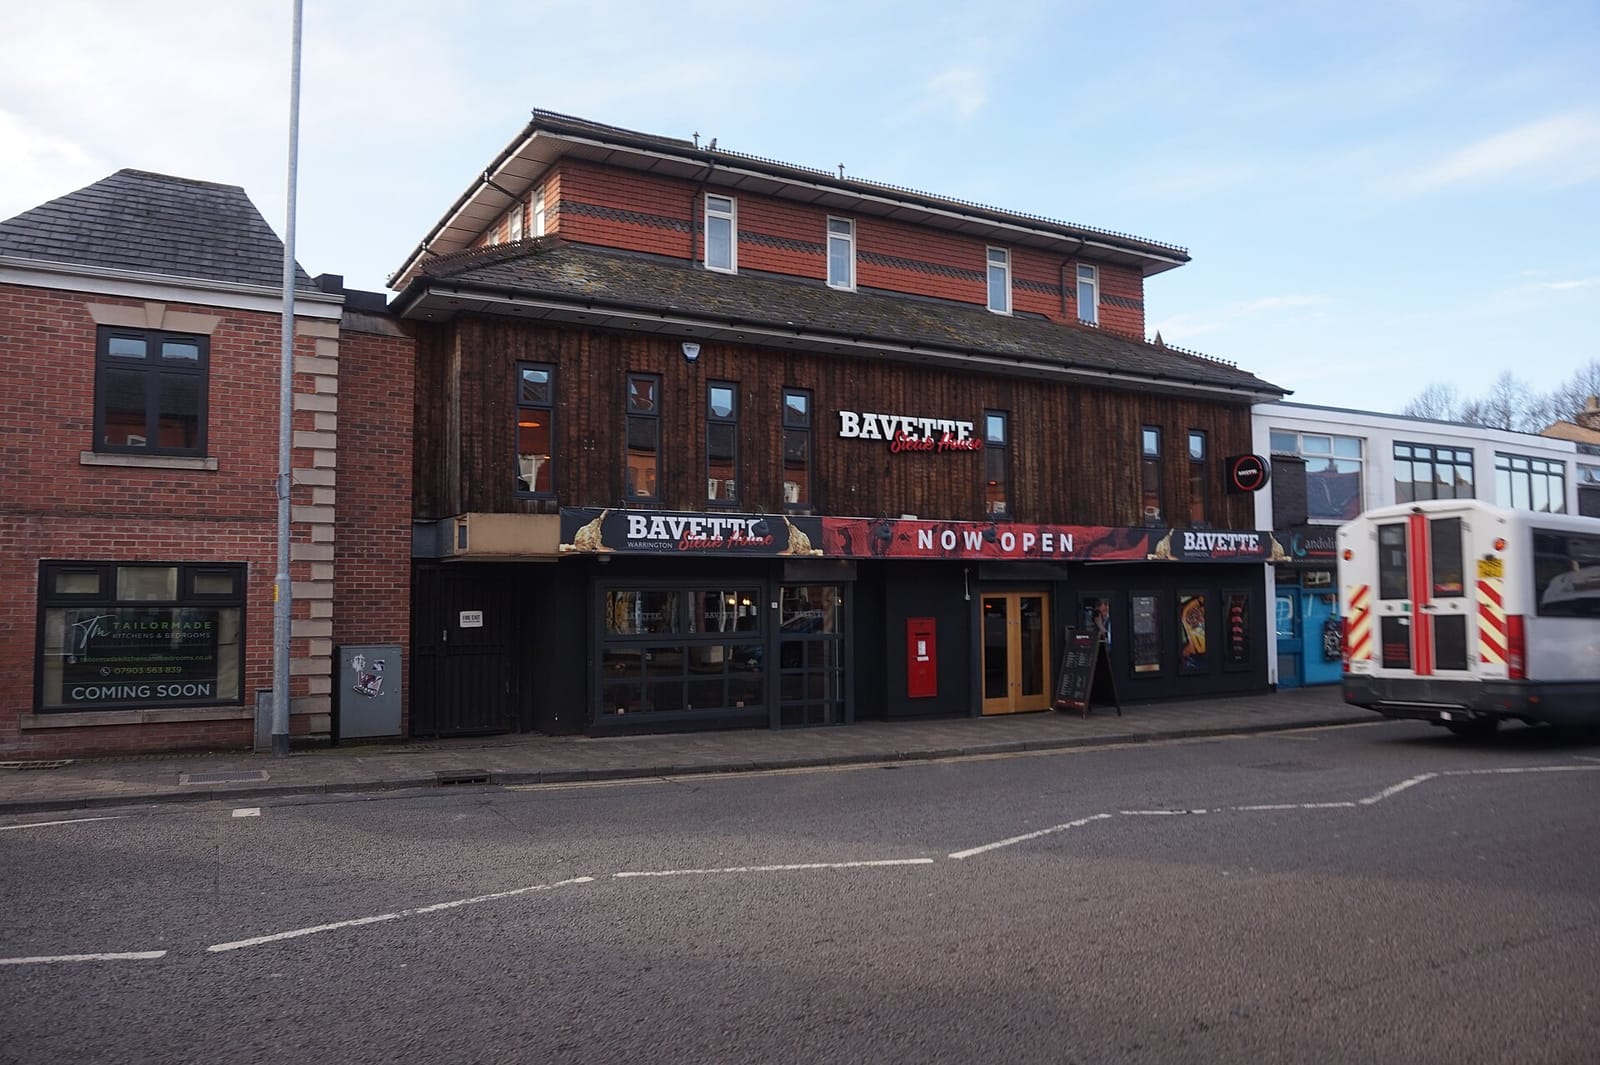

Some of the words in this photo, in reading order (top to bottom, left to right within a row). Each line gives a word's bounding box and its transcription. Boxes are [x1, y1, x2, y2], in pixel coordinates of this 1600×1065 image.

[839, 411, 974, 443] BAVETTE
[890, 430, 934, 453] Steak
[937, 430, 983, 453] House
[626, 541, 673, 550] WARRINGTON
[917, 529, 983, 551] NOW
[1001, 532, 1074, 553] OPEN
[1183, 532, 1260, 551] BAVETTE
[1291, 532, 1337, 559] Candoli
[112, 632, 155, 640] KITCHENS
[164, 631, 211, 639] BEDROOMS
[113, 621, 212, 631] TAILORMADE
[71, 685, 151, 701] COMING
[156, 683, 211, 698] SOON
